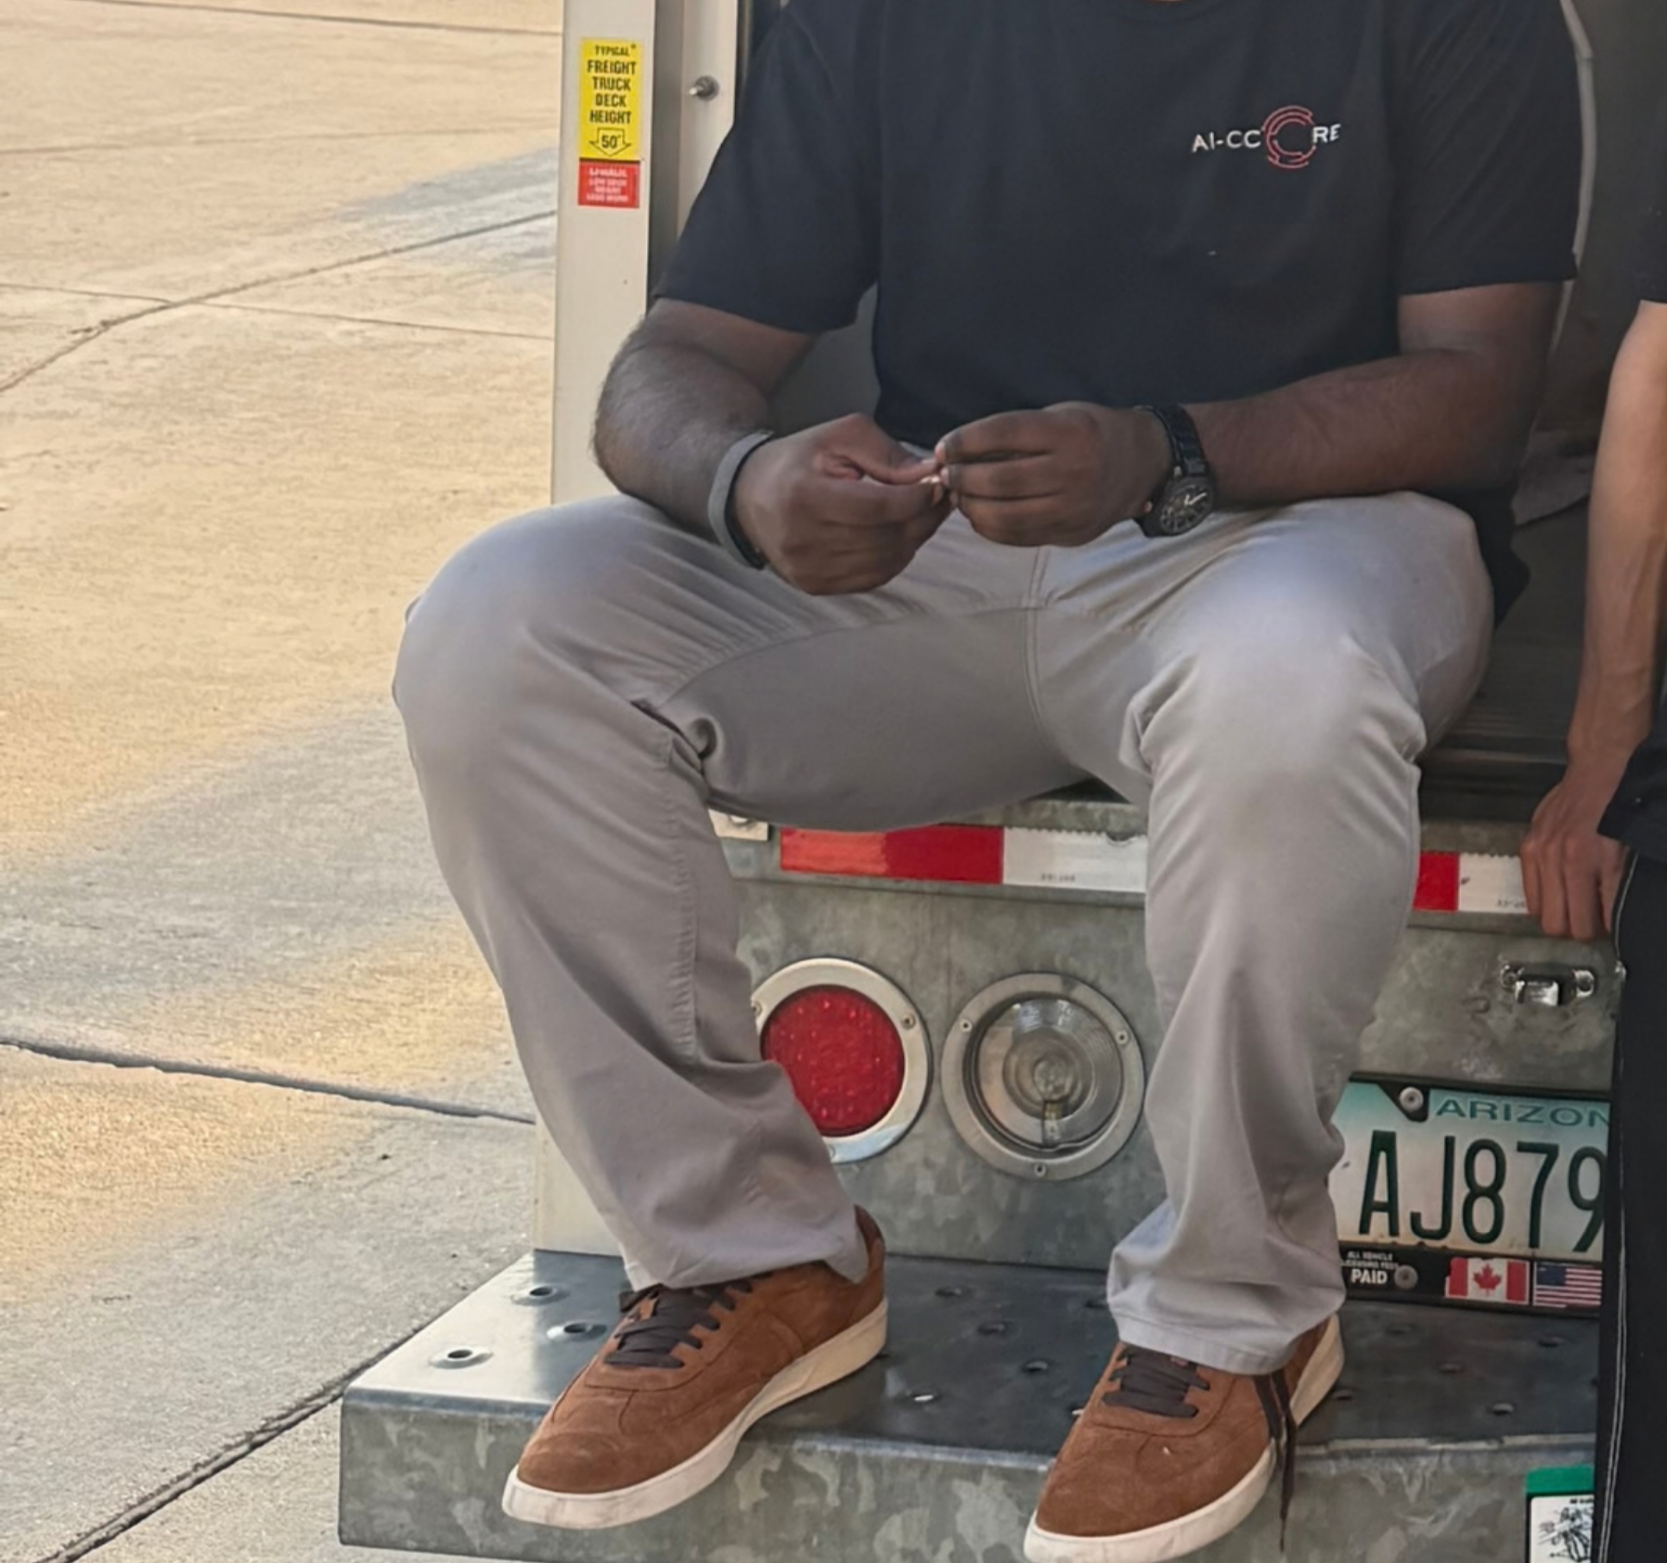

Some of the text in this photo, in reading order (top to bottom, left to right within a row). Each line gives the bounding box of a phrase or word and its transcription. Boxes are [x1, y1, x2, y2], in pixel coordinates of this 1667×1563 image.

[595, 45, 630, 56] TYPICAL
[587, 59, 637, 75] FREIGHT
[592, 76, 631, 91] TRUCK
[595, 93, 626, 107] DECK
[589, 110, 632, 124] HEIGHT
[1359, 1130, 1608, 1254] AJ879
[1351, 1268, 1388, 1285] PAID
